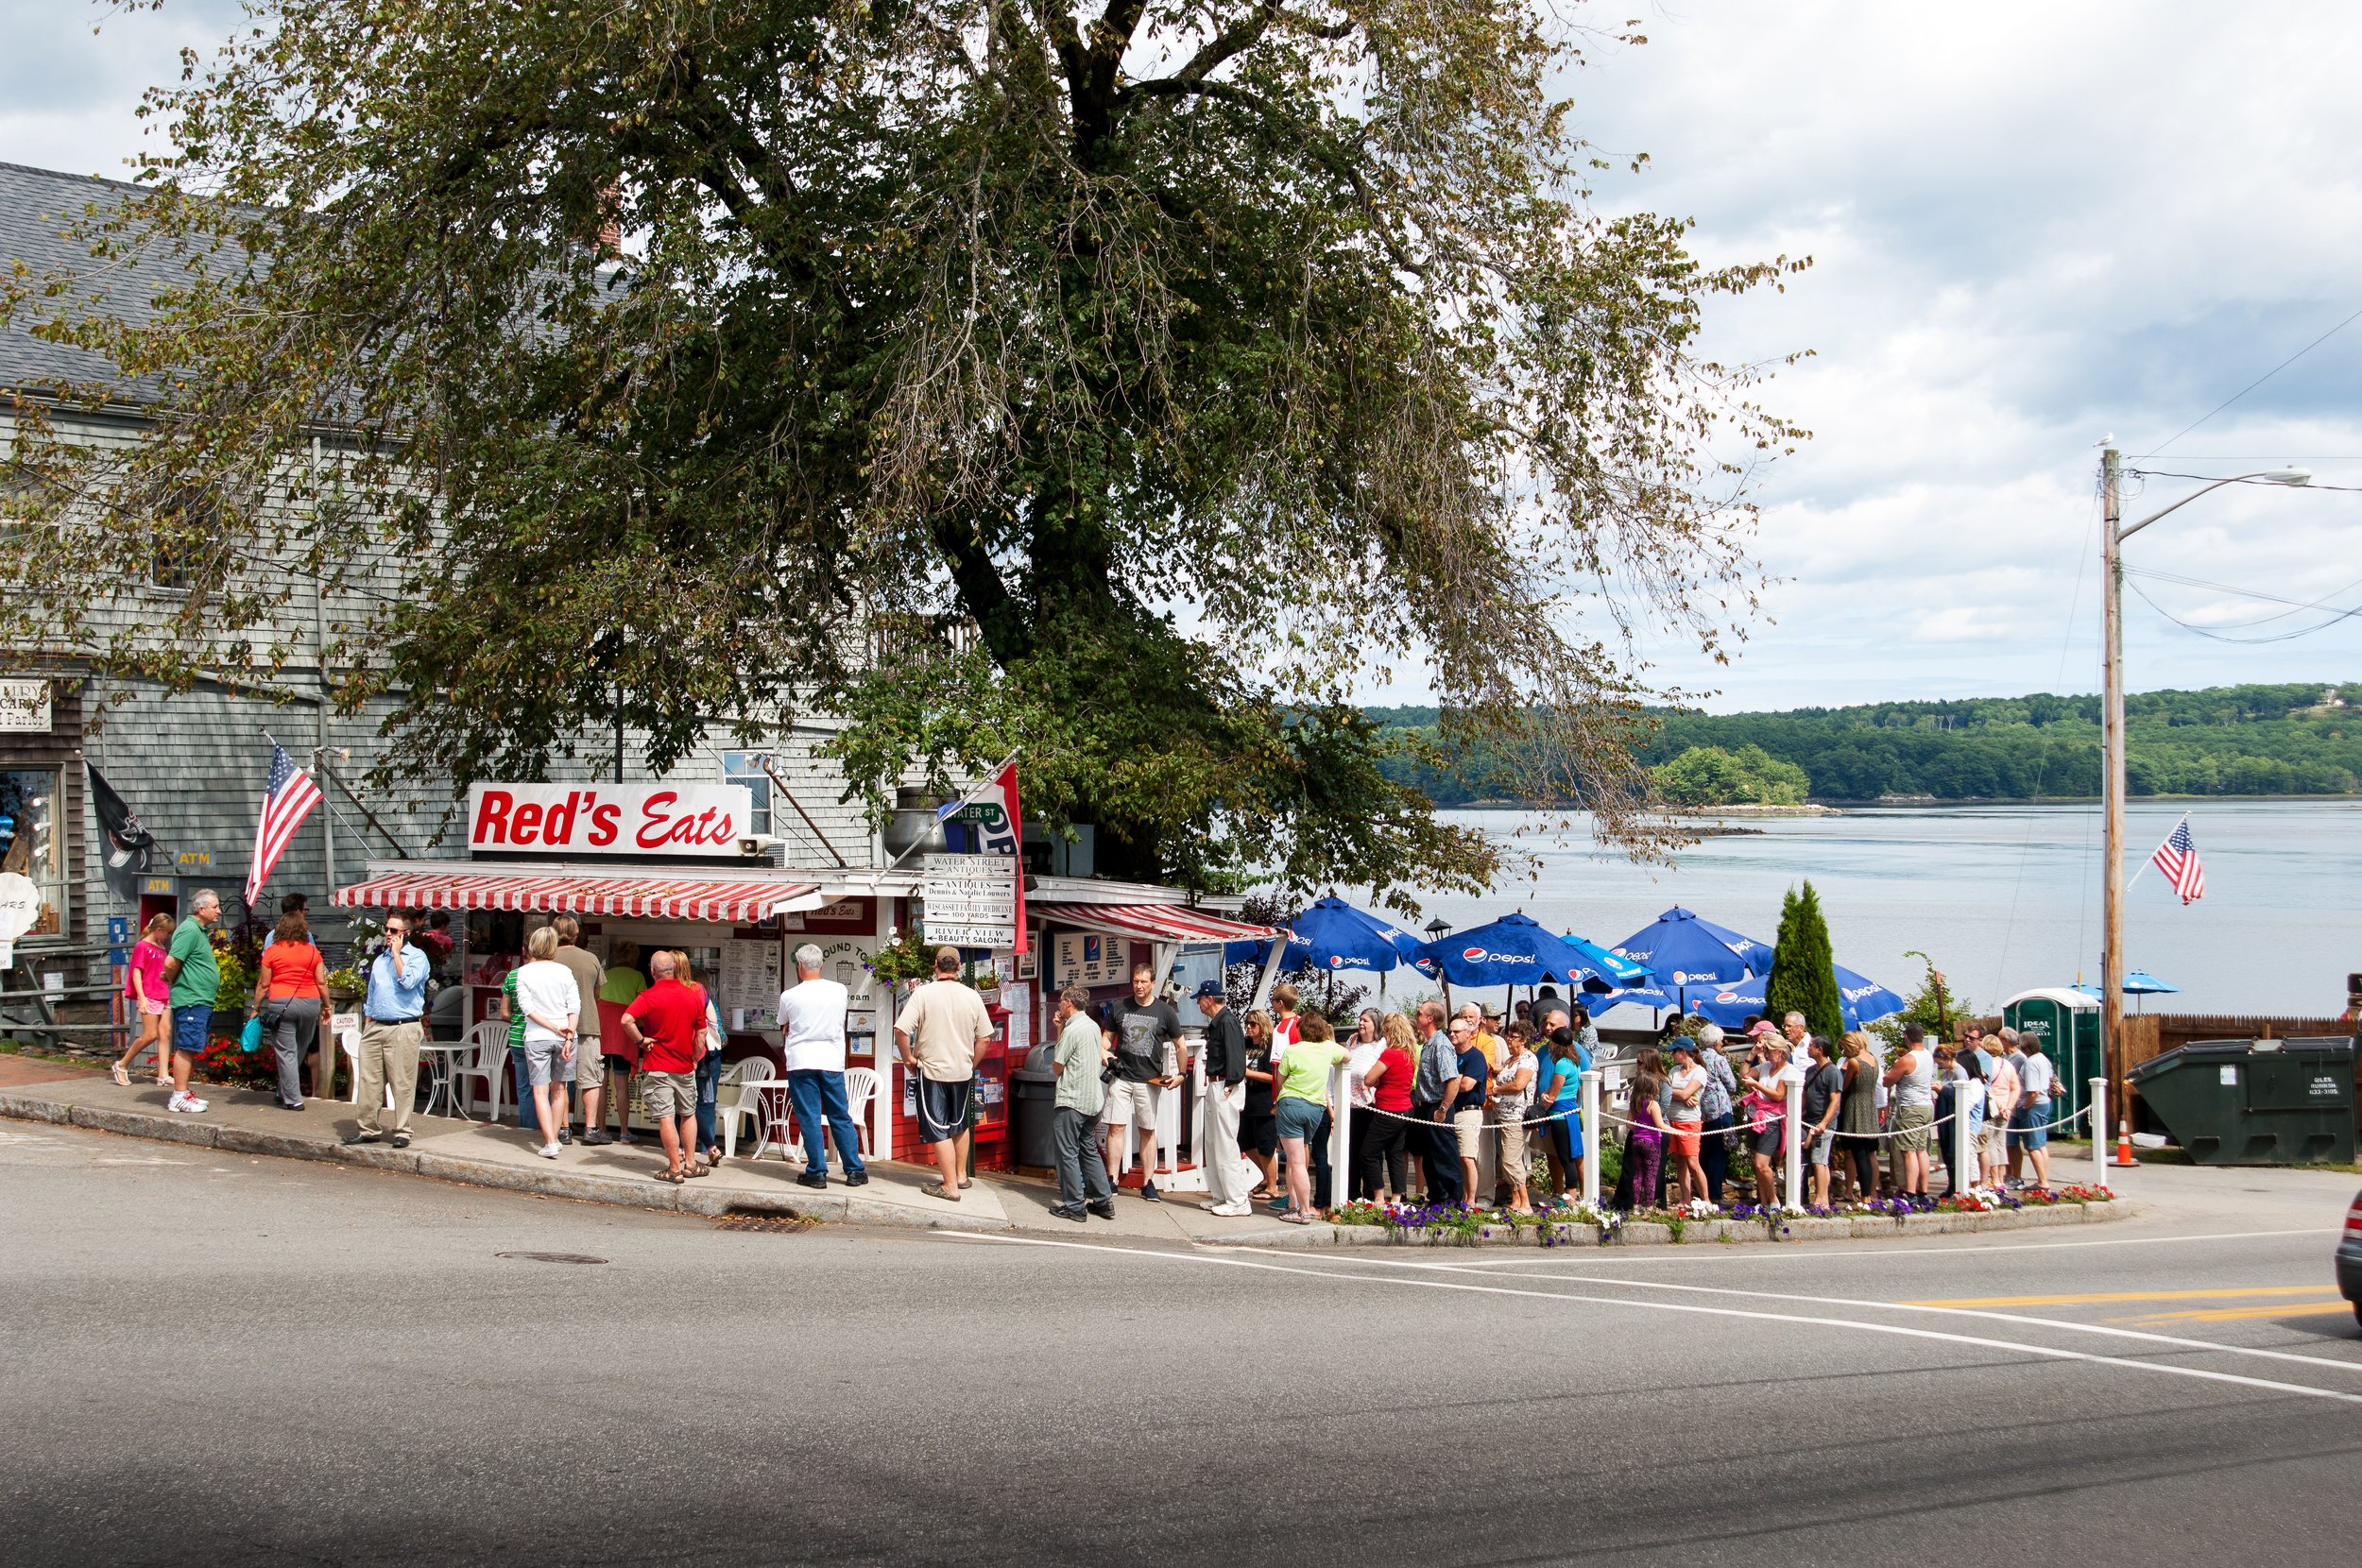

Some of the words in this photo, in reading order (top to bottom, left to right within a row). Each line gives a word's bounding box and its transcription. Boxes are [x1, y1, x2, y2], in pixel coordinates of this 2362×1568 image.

[7, 712, 43, 725] Parlor
[984, 808, 995, 817] ST
[472, 791, 621, 846] Red's
[636, 791, 737, 849] Eats
[179, 852, 211, 865] ATM
[933, 857, 966, 866] WATER
[970, 858, 1007, 867] STREET
[946, 866, 993, 875] ANTIQUES
[147, 879, 169, 892] ATM
[945, 880, 992, 890] ANTIQUES
[959, 889, 982, 897] Natalie
[839, 905, 855, 916] Eats
[927, 903, 959, 912] WISCASSET
[960, 904, 982, 913] FAMILY
[983, 905, 1013, 914] MEDICINE
[934, 928, 969, 936] RIVER
[1293, 936, 1314, 946] psi
[822, 943, 851, 962] OUND
[1344, 957, 1370, 966] pepsi
[1488, 953, 1535, 964] pepsi
[1688, 972, 1718, 982] pepsi
[1855, 982, 1883, 998] pepsi
